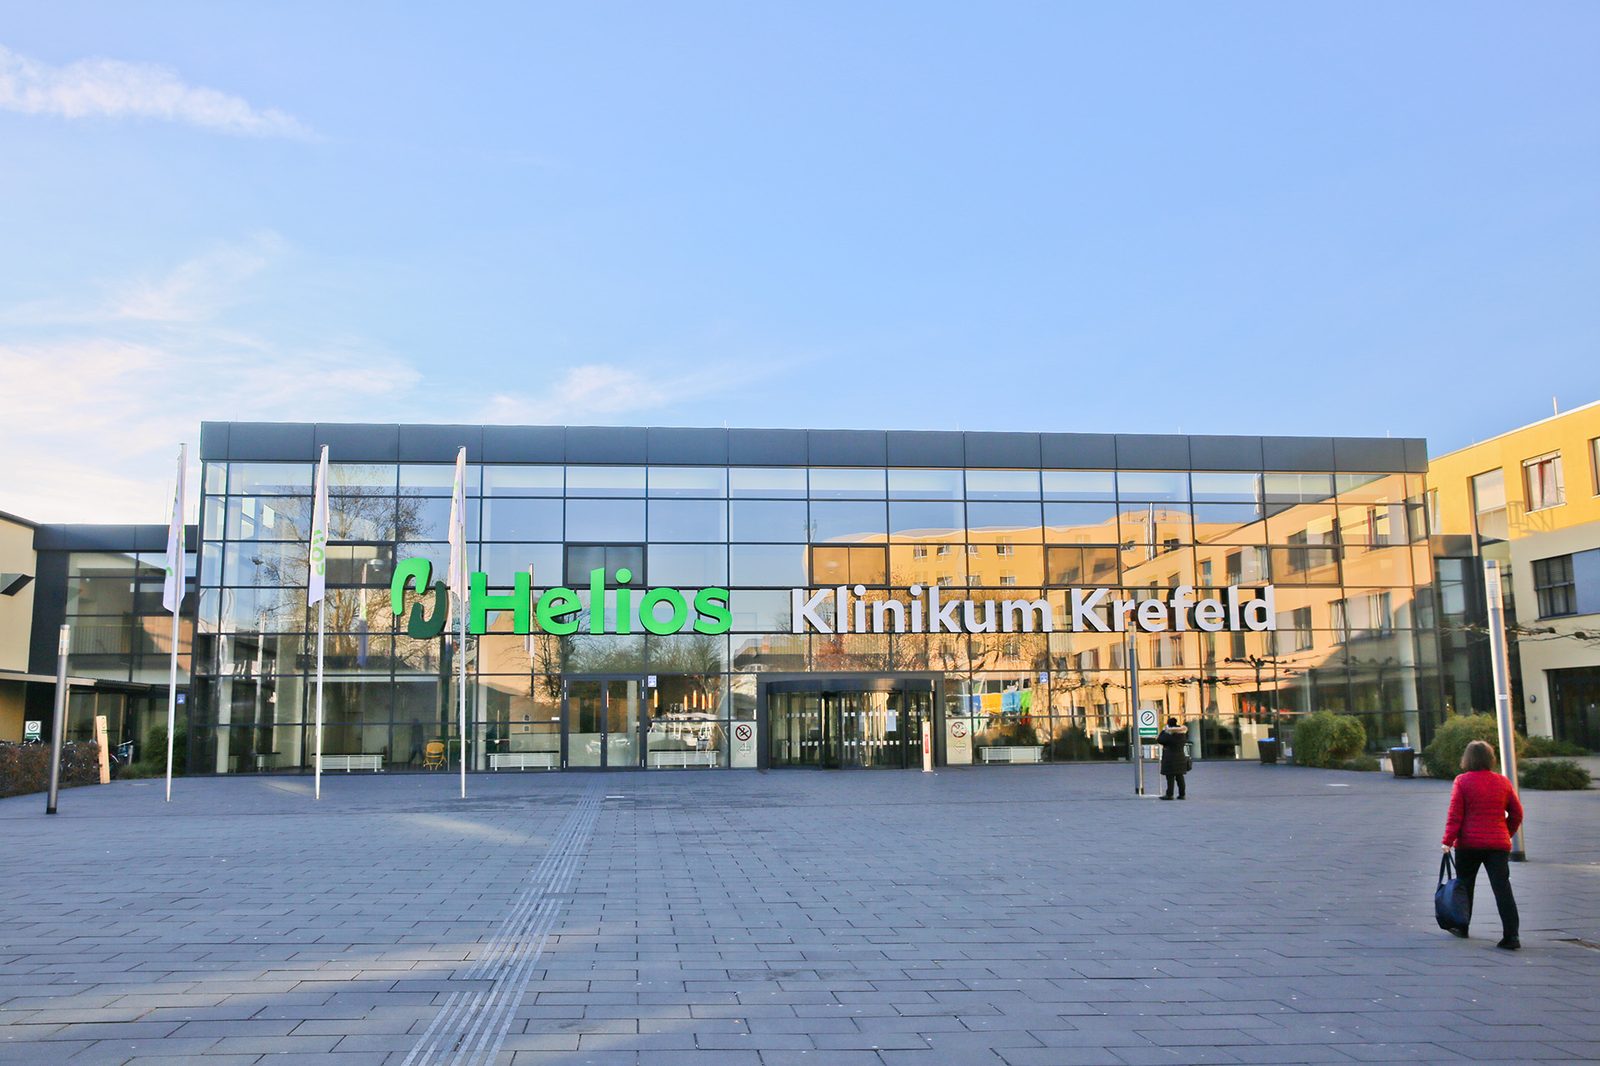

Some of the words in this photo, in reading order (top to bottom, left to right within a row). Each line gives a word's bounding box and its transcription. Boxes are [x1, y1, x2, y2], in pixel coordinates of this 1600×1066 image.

[470, 568, 732, 636] Helios
[791, 584, 1053, 634] Klinikum
[1071, 585, 1277, 632] Krefeld
